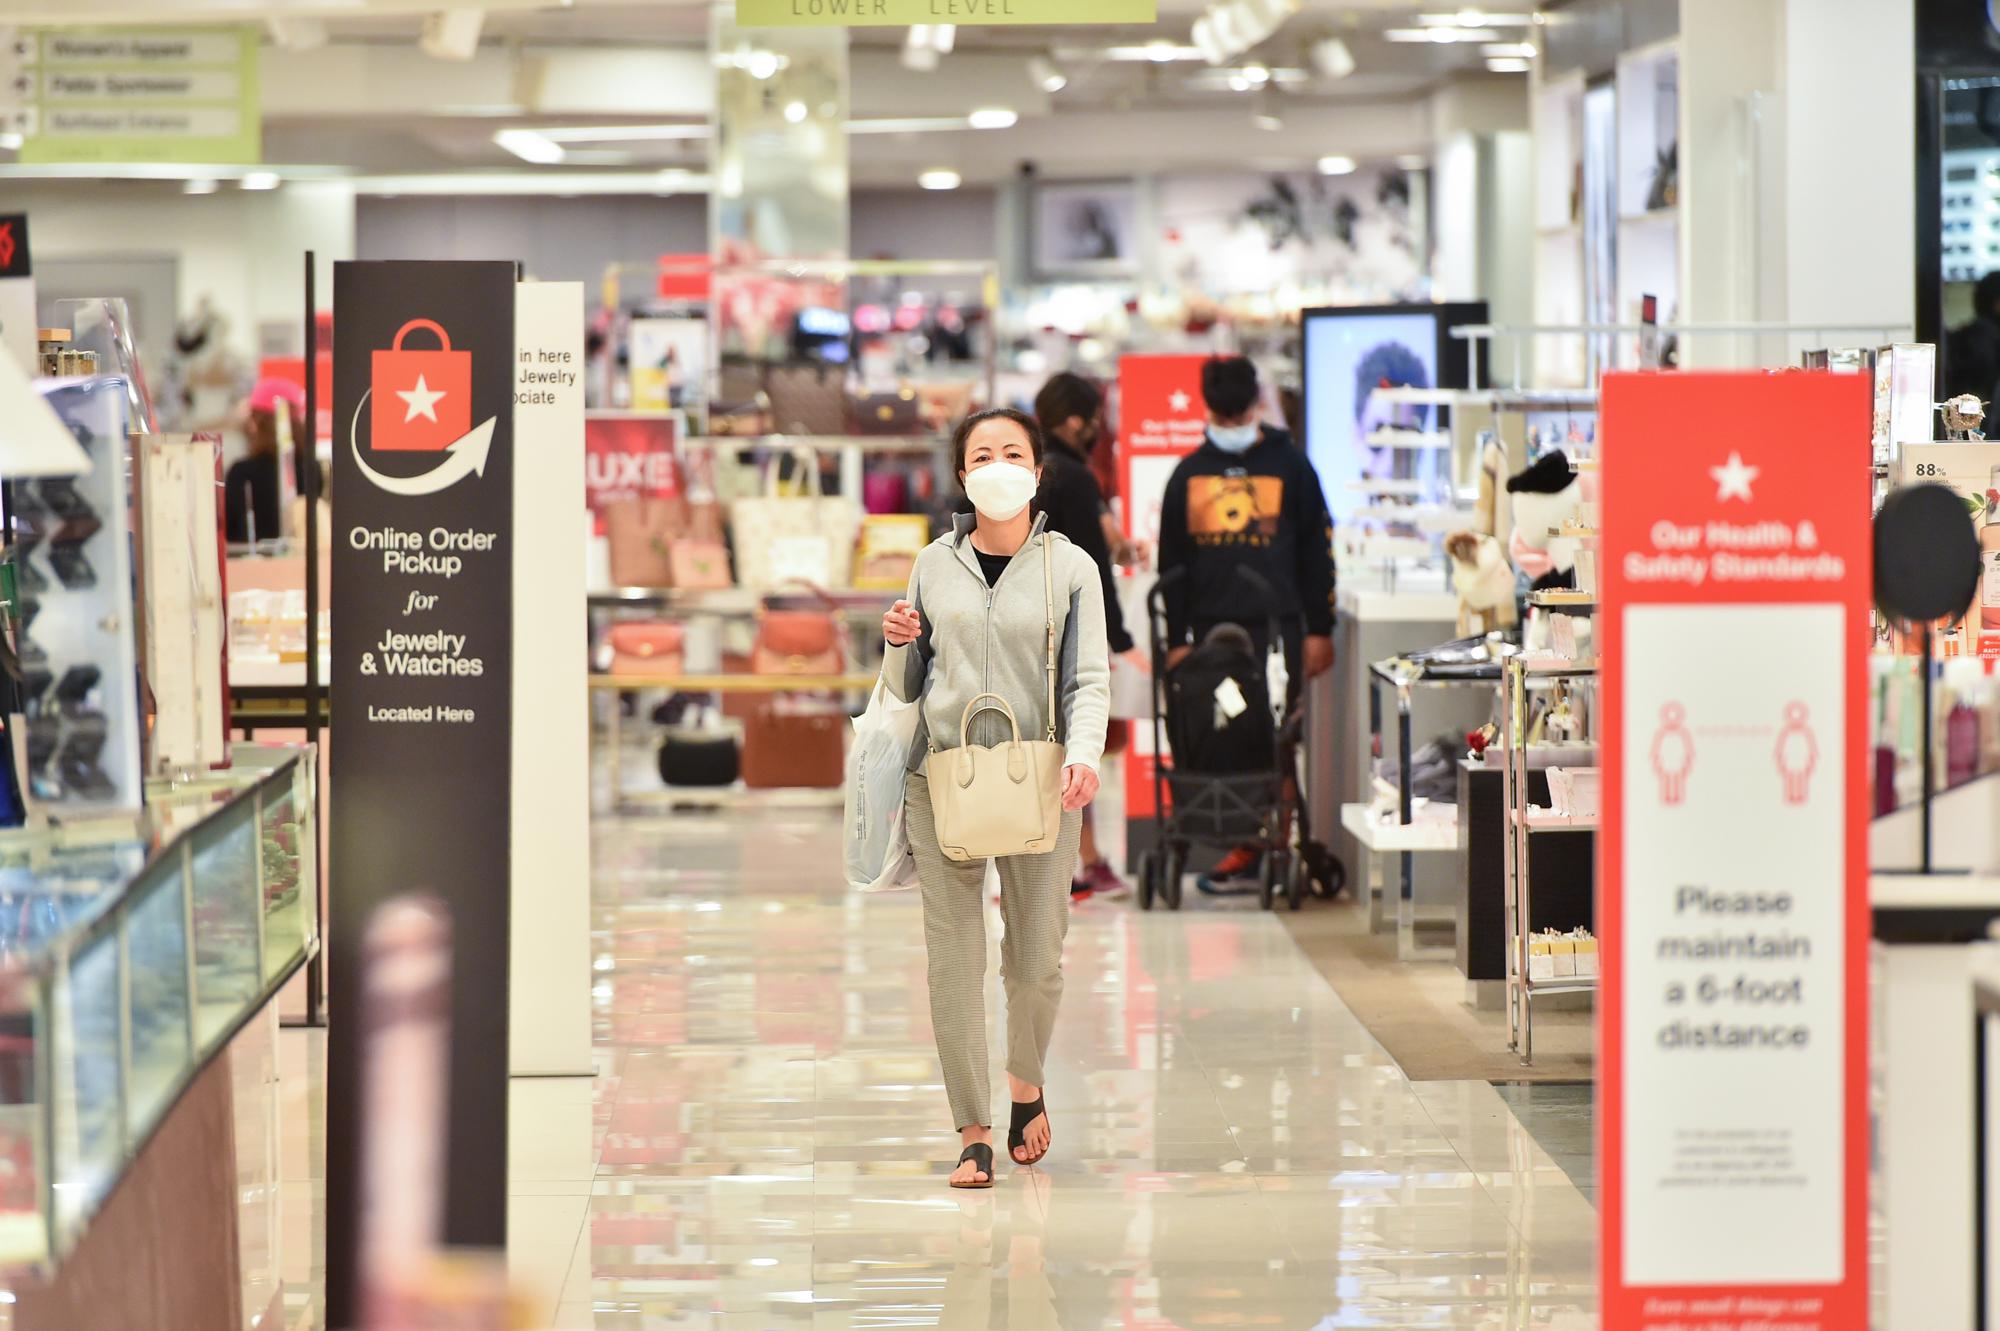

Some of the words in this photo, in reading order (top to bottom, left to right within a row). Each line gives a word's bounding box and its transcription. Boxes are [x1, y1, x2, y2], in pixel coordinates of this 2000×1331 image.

[792, 0, 887, 16] LOWER
[930, 0, 1014, 15] LEVEL
[519, 348, 532, 363] in
[538, 348, 572, 363] here
[519, 368, 576, 386] Jewelry
[350, 527, 423, 550] Online
[429, 527, 497, 550] Order
[1651, 519, 1703, 550] Our
[1706, 519, 1792, 549] Health
[1795, 519, 1817, 549] &
[384, 551, 462, 578] Pickup
[1623, 551, 1708, 587] Safety
[1711, 551, 1846, 581] Standards
[402, 590, 439, 616] for
[378, 629, 466, 657] Jewelry
[360, 652, 378, 676] &
[384, 653, 484, 676] Watches
[368, 705, 433, 722] Located
[437, 706, 475, 722] Here
[1675, 885, 1793, 915] Please
[1657, 929, 1811, 959] maintain
[1665, 982, 1685, 1004] a
[1698, 975, 1803, 1005] 6-foot
[1658, 1020, 1811, 1050] distance
